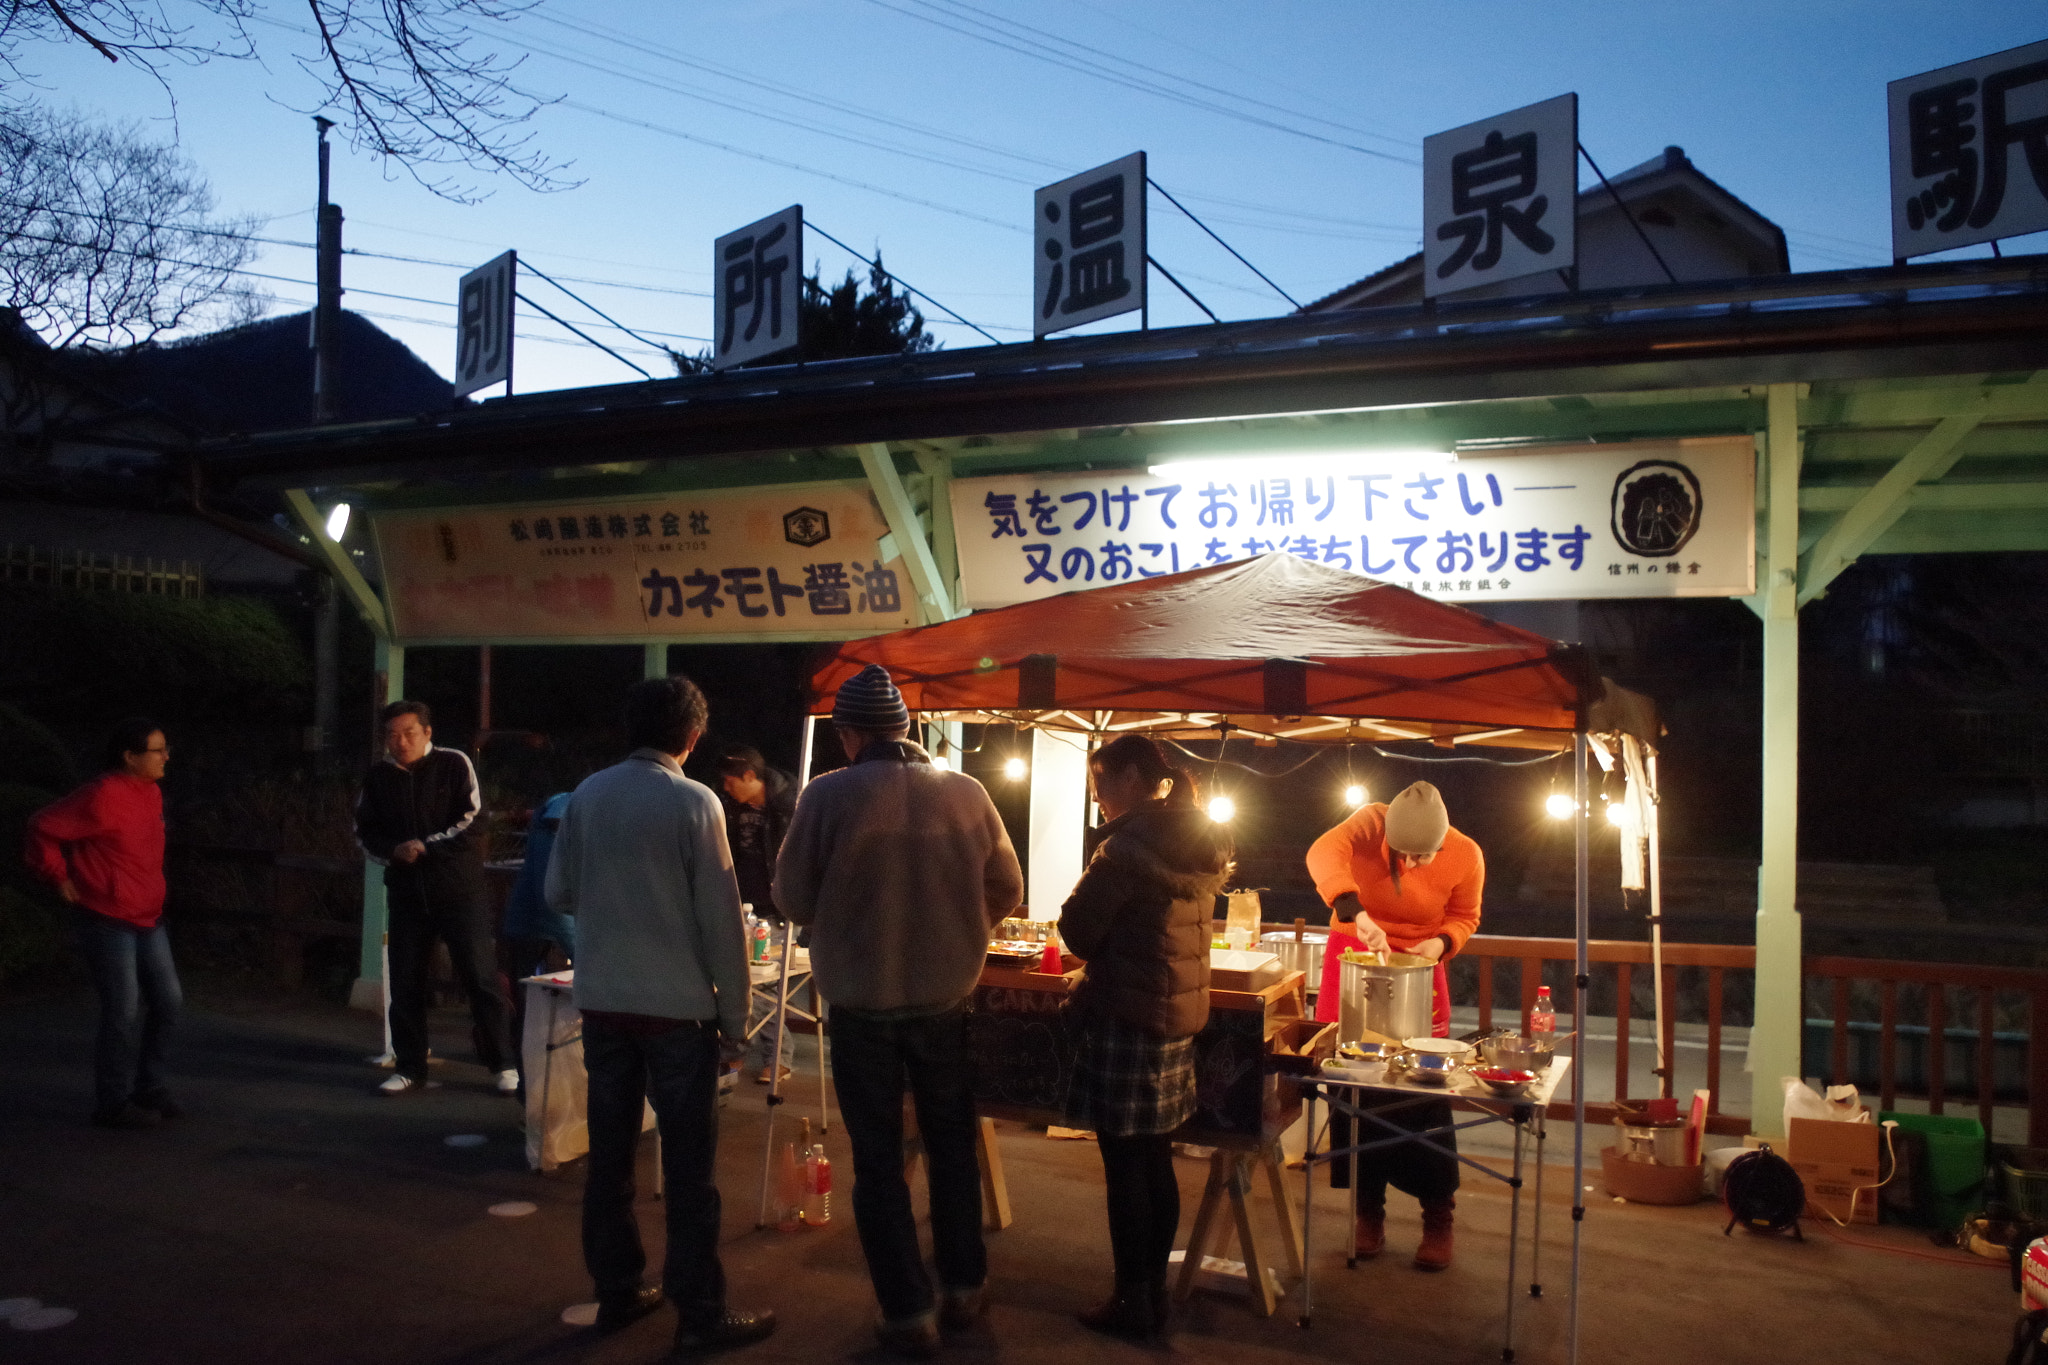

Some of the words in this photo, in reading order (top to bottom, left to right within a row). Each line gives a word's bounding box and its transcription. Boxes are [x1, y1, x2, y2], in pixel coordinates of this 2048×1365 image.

[458, 264, 506, 381] 別
[720, 221, 790, 355] 所
[1043, 173, 1132, 320] 温
[1436, 129, 1555, 279] 泉
[1906, 58, 2048, 234] 駅
[642, 560, 901, 618] カネモト醤油
